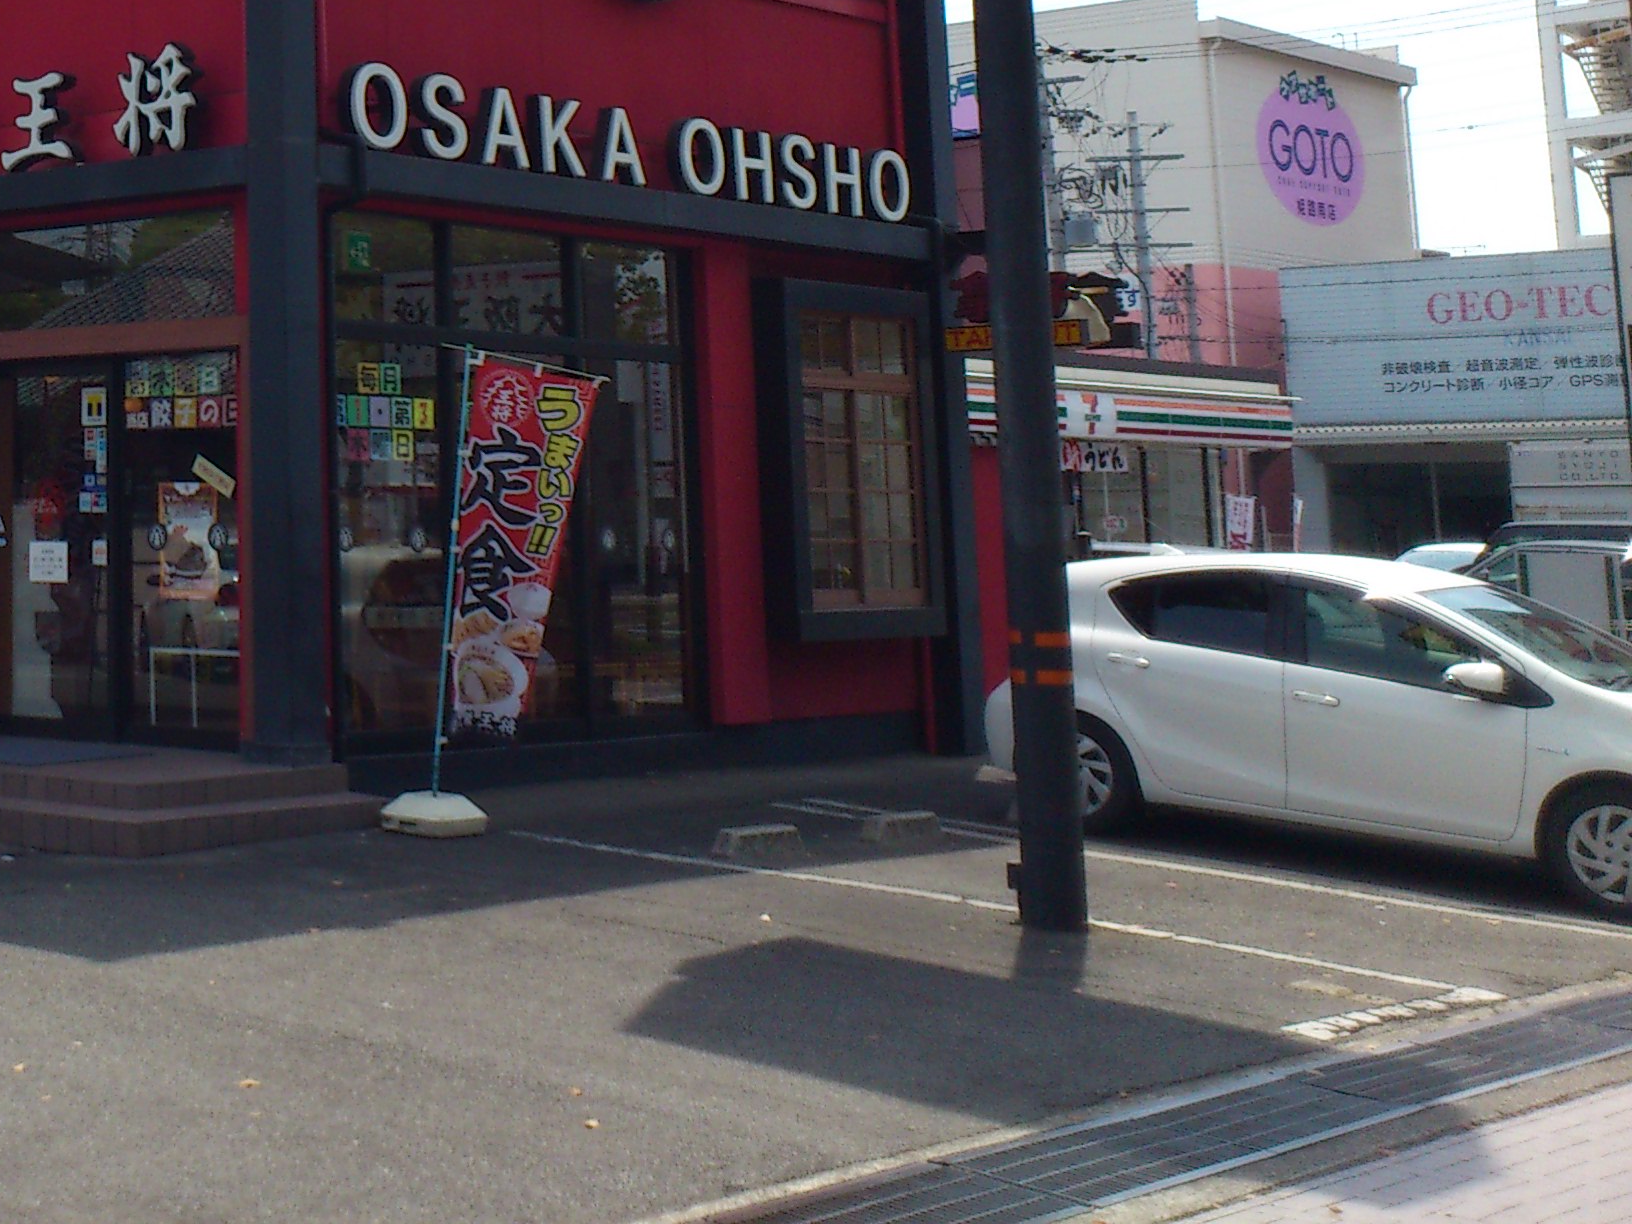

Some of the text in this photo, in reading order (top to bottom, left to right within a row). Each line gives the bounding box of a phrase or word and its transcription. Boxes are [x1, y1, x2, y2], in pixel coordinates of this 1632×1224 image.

[349, 60, 911, 223] OSAKA OHSHO
[1270, 119, 1354, 183] GOTO
[459, 426, 542, 622] 定食
